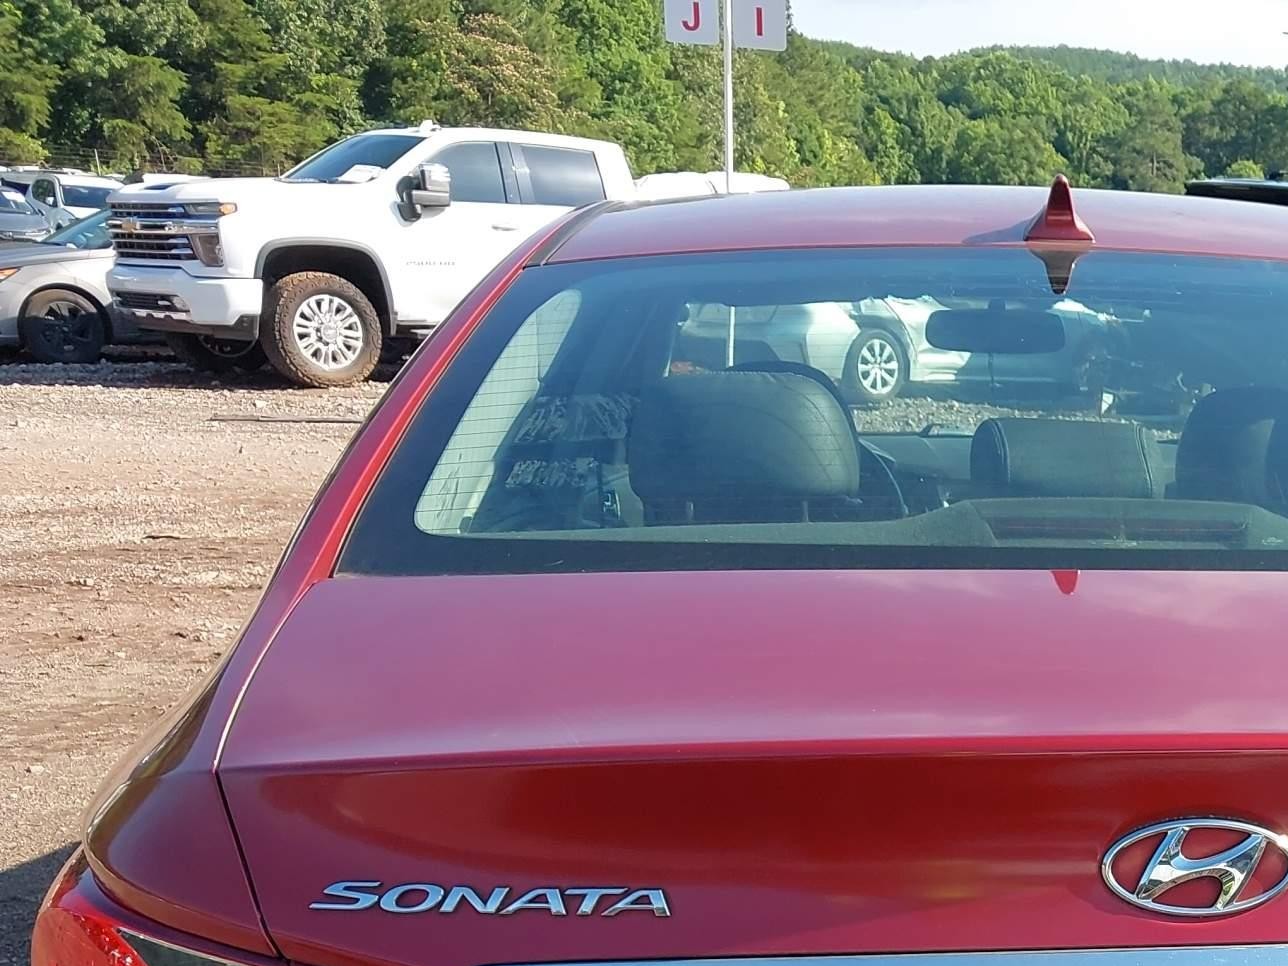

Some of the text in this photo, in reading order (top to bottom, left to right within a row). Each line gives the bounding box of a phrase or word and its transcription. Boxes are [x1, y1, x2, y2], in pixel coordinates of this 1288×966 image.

[681, 1, 701, 31] J
[755, 7, 764, 36] I
[309, 880, 671, 917] SONATA
